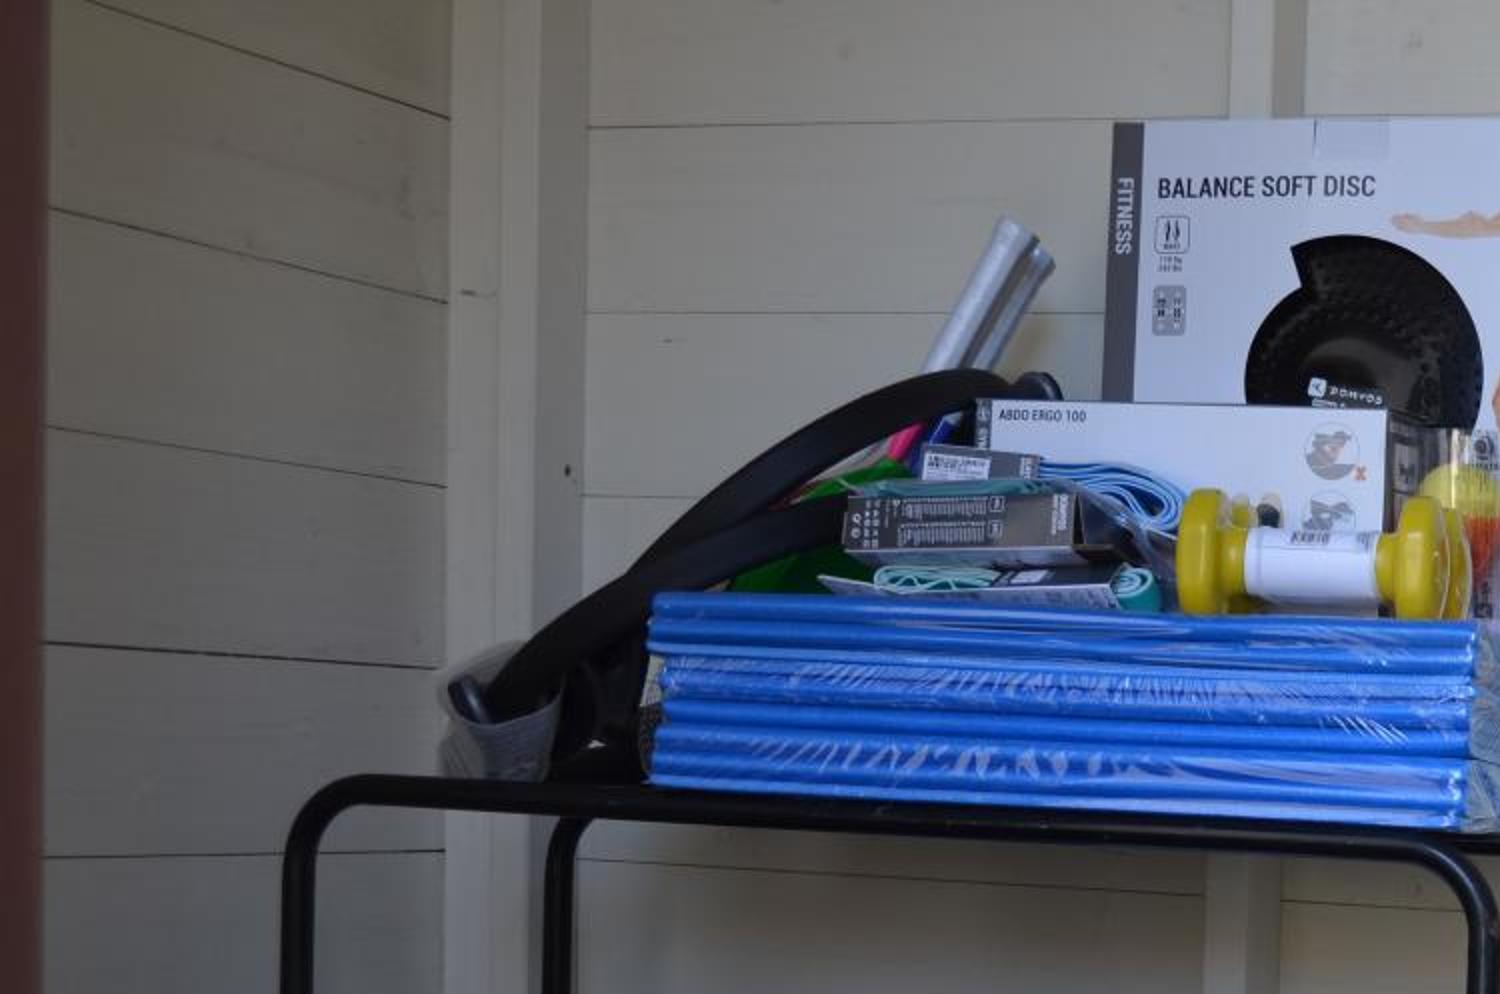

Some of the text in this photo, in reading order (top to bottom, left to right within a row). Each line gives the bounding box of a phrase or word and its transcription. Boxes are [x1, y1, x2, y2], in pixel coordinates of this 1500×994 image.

[1157, 175, 1377, 199] BALANCE SOFT DISC
[1115, 177, 1135, 256] FITNESS
[1000, 408, 1087, 423] ABDO ERGO 100
